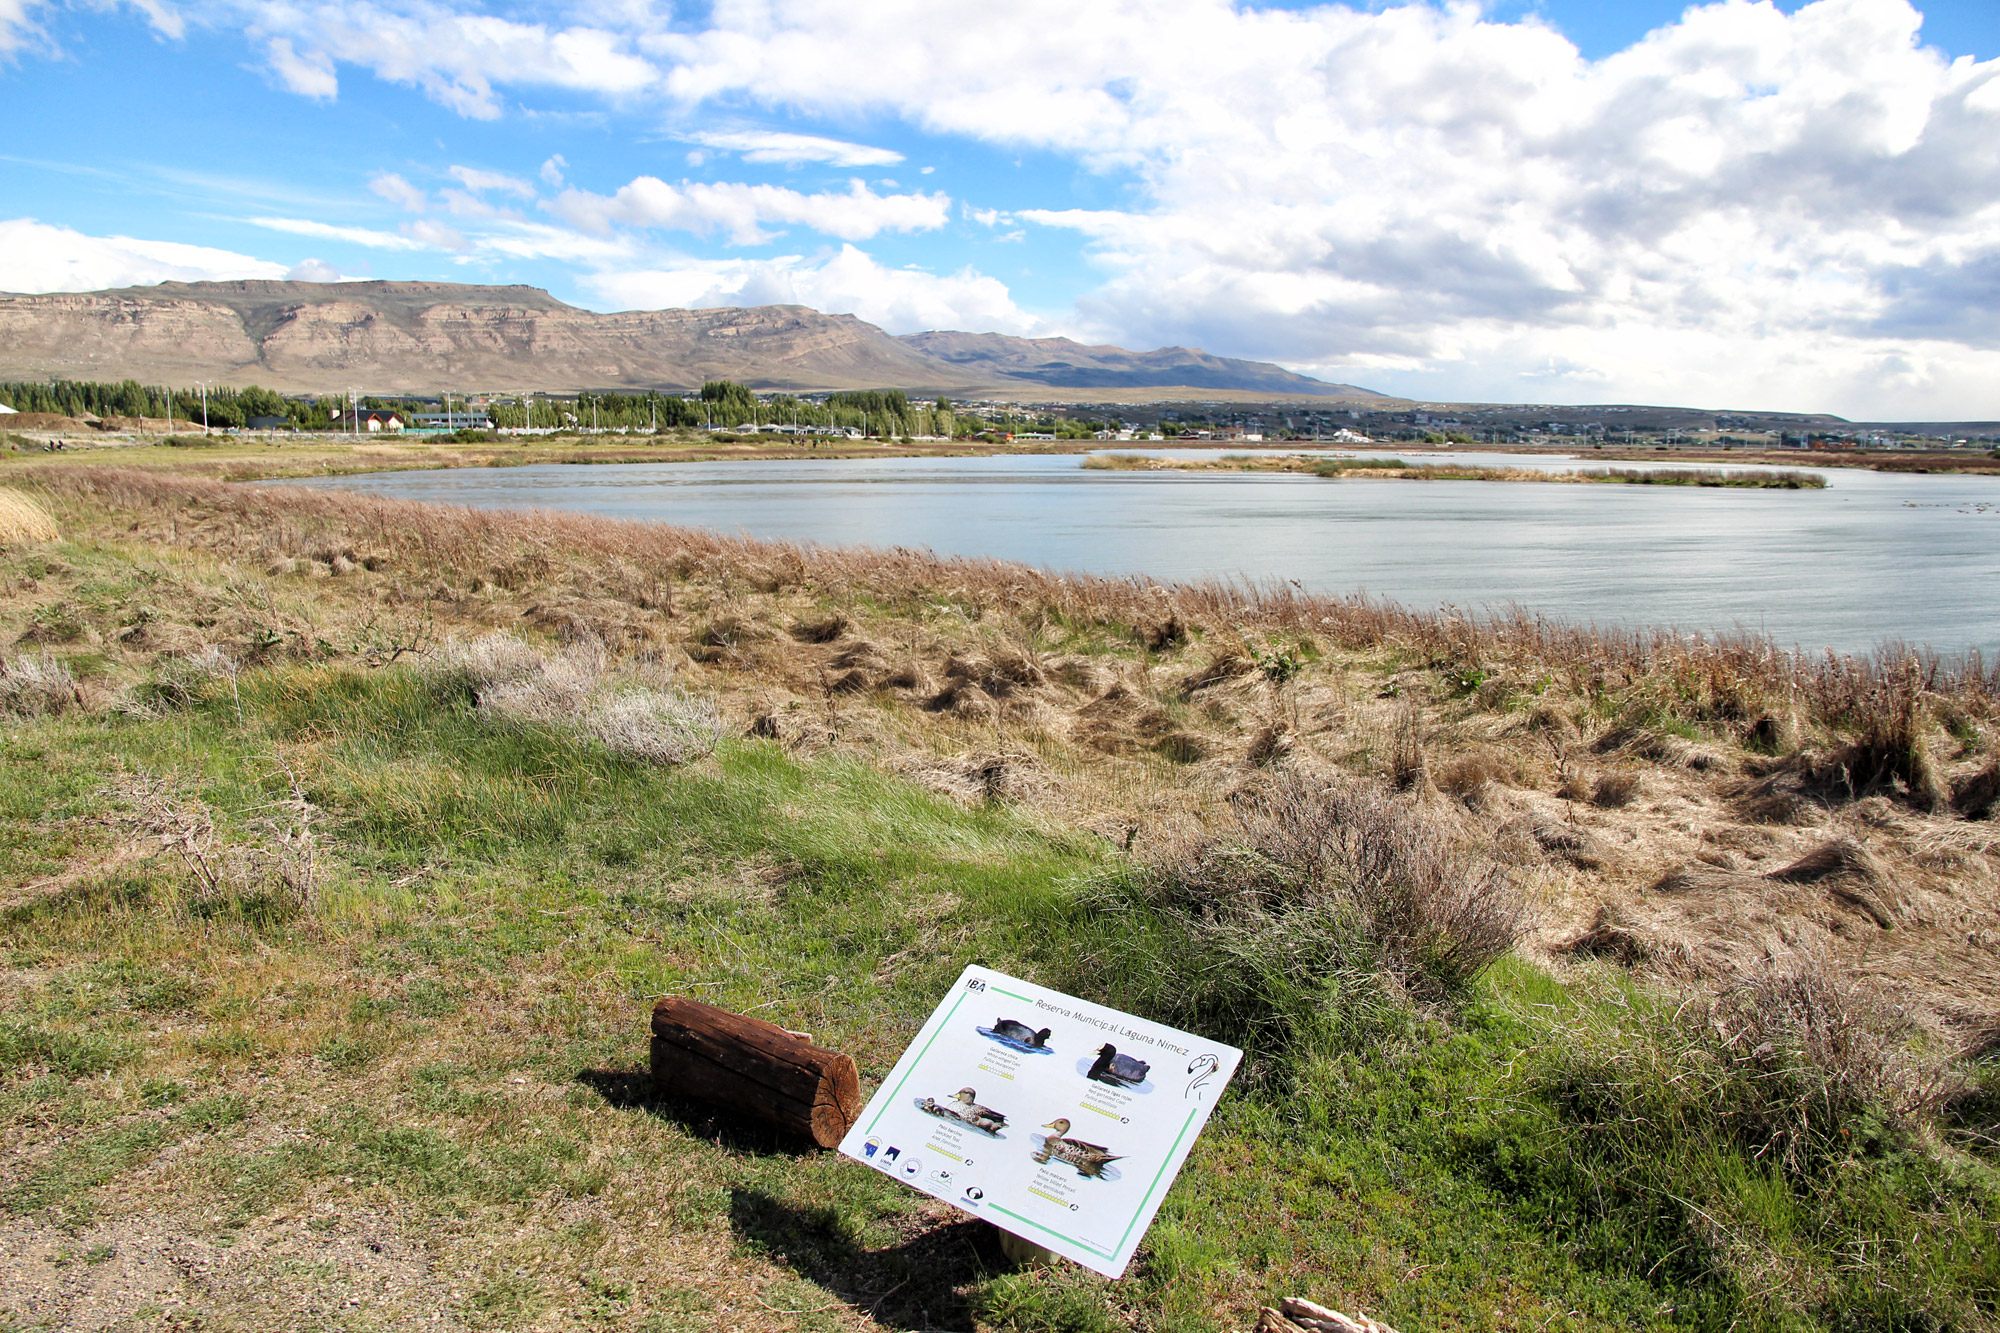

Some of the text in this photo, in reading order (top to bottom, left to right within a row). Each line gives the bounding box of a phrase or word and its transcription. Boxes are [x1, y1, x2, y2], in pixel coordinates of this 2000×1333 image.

[1035, 999, 1189, 1056] Reserva Municipal Laguna Nimez
[1091, 1083, 1110, 1093] Gallareta
